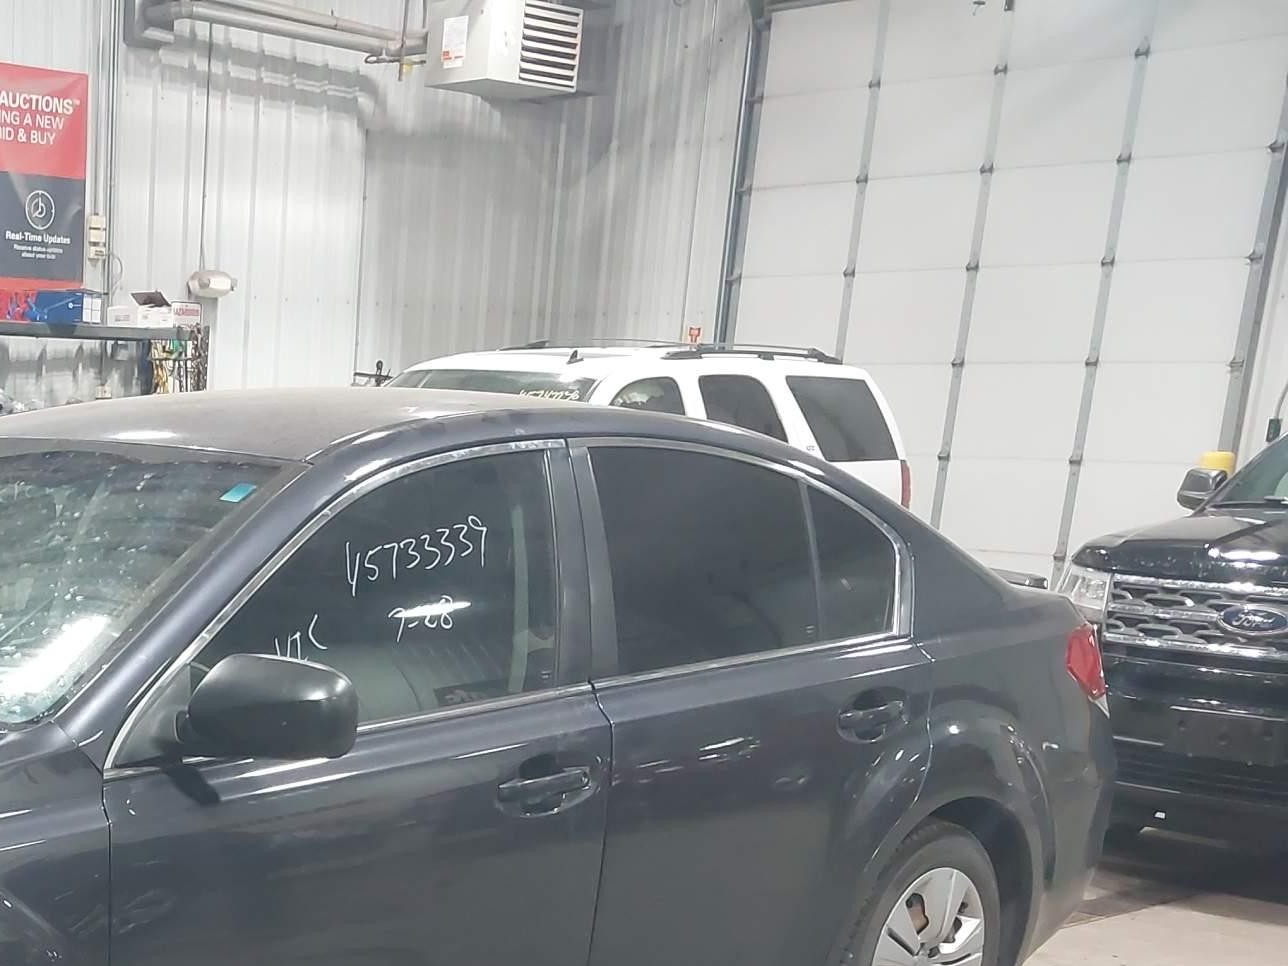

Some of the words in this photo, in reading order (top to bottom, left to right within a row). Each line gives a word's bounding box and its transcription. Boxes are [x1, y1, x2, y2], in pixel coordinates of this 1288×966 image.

[23, 114, 33, 127] A
[35, 115, 64, 130] NEW
[16, 128, 27, 142] &
[30, 130, 56, 145] BUY
[6, 230, 42, 242] Real-Time
[43, 234, 71, 244] Updates
[345, 515, 488, 597] 45733339
[1232, 612, 1276, 628] Ford
